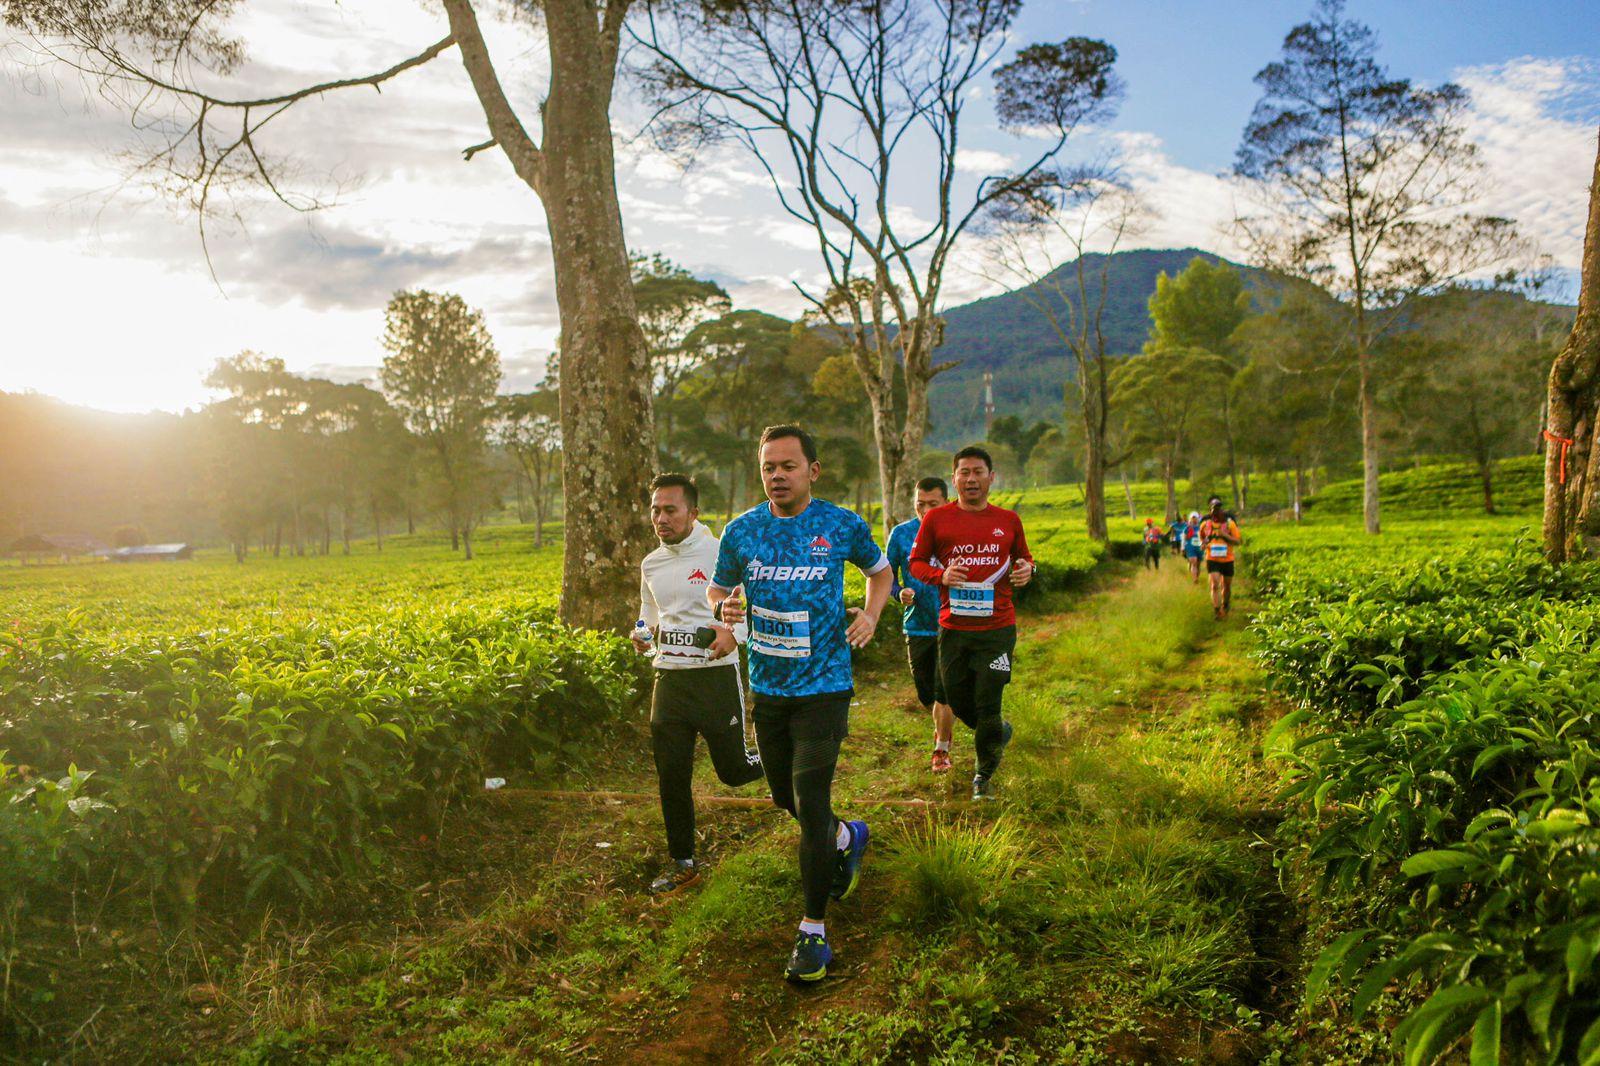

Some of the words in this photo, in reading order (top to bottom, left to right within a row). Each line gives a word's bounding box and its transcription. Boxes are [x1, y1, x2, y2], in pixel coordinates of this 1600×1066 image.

[952, 544, 974, 554] AYO
[977, 544, 999, 553] LARI
[748, 565, 828, 581] JABAR
[957, 589, 985, 601] 1303
[760, 620, 794, 637] 1301
[665, 632, 694, 646] 1150
[989, 663, 1010, 671] adidas
